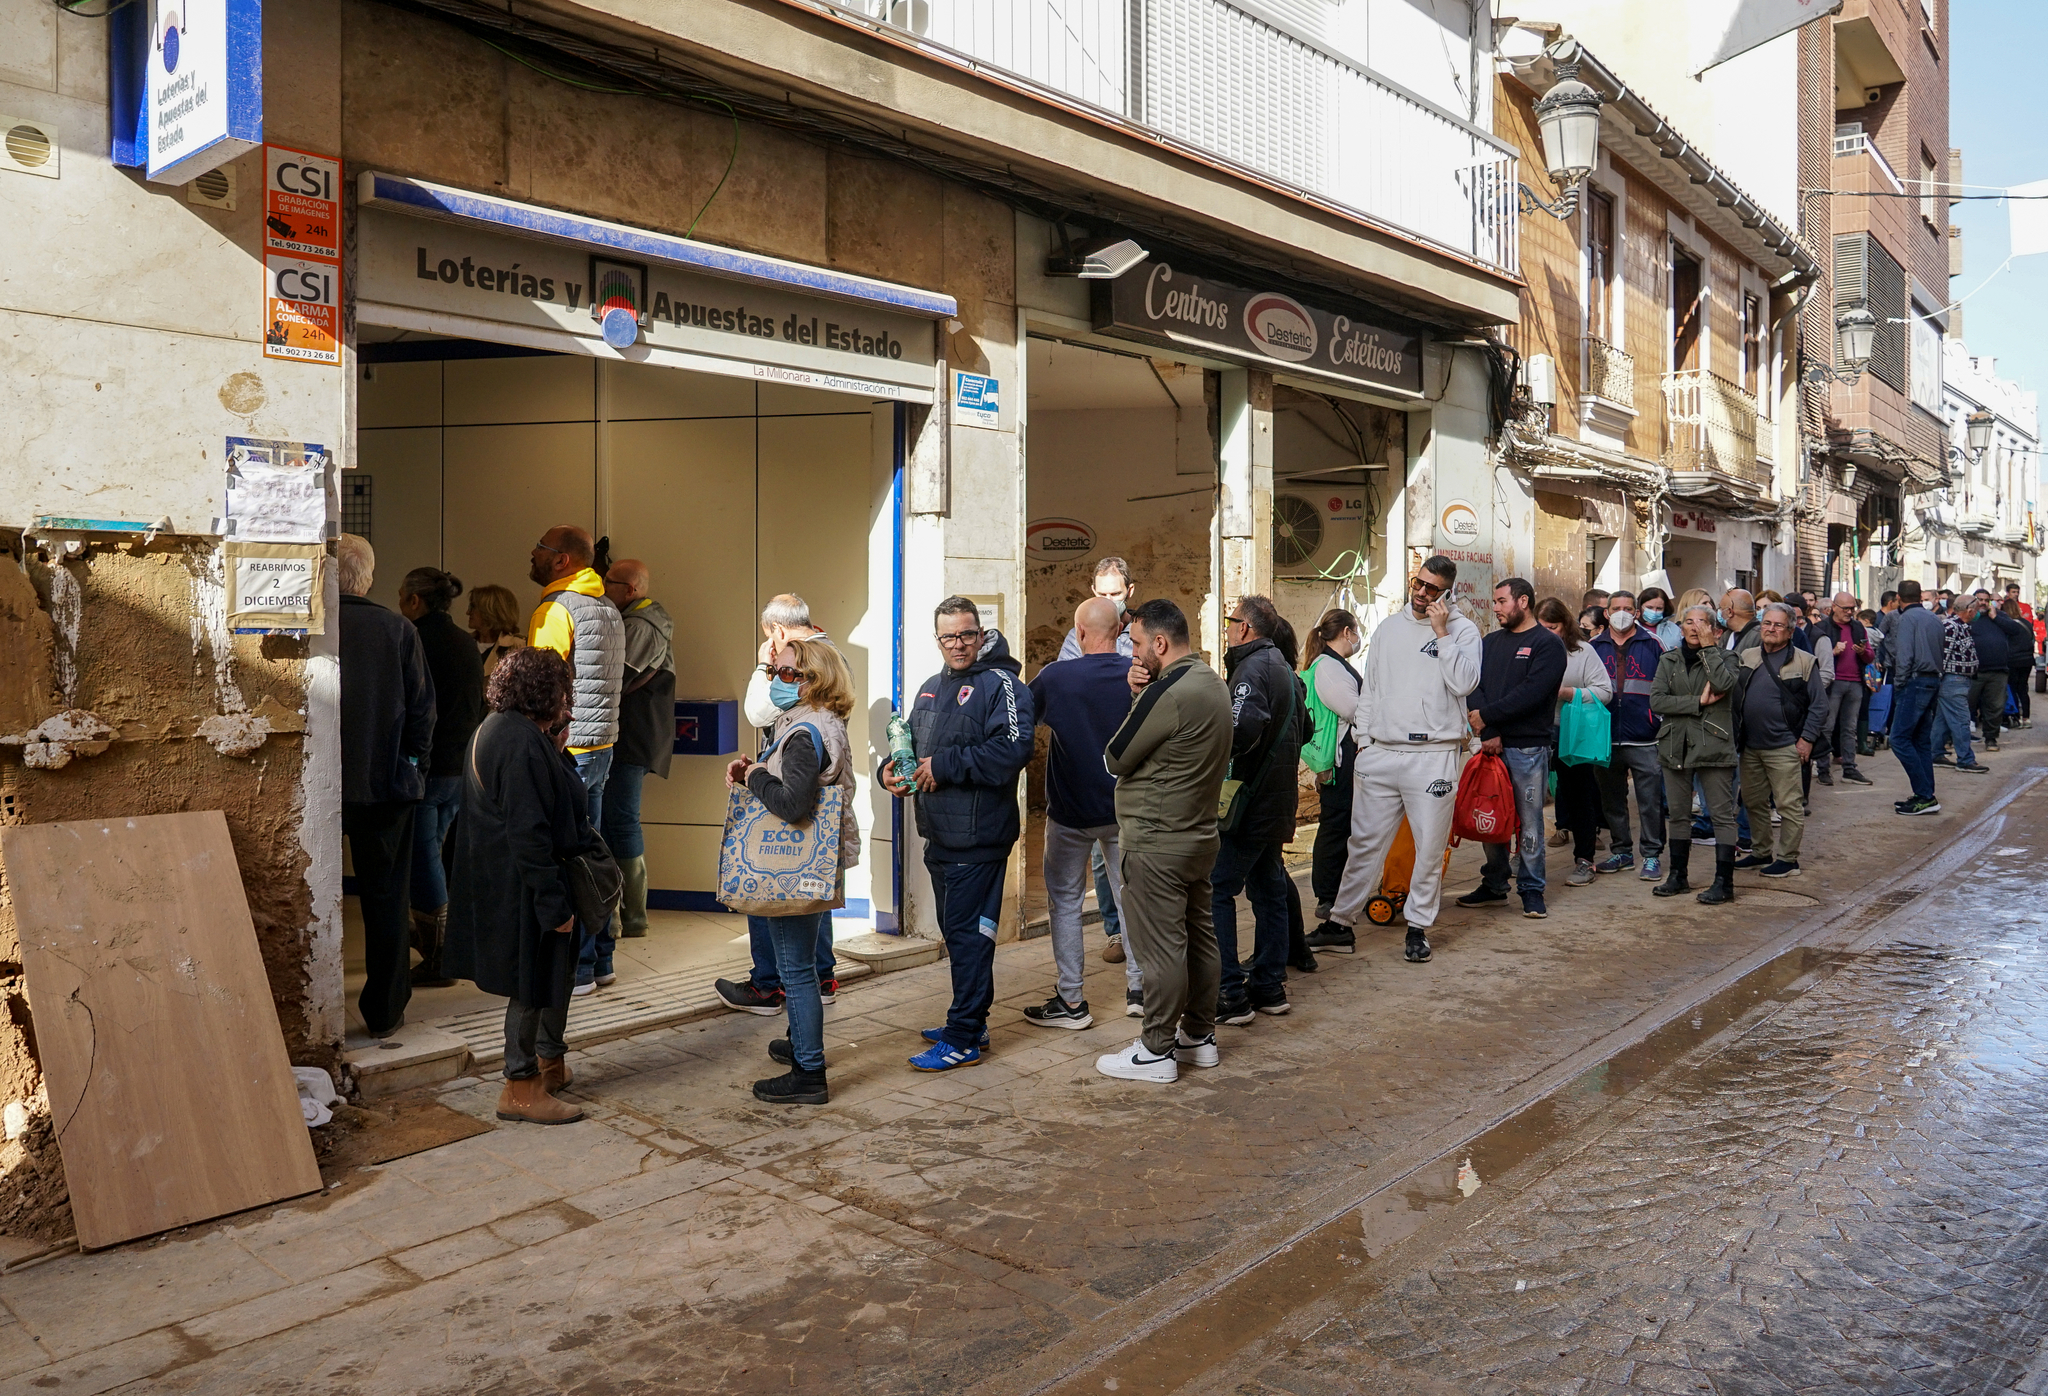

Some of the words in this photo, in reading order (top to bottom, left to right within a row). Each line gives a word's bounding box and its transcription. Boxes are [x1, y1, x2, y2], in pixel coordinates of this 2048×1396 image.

[158, 96, 194, 131] Apuestas
[195, 81, 208, 107] del
[157, 123, 184, 154] Estado
[276, 162, 330, 200] CSI
[277, 194, 329, 211] GRABACIÓN
[278, 203, 290, 212] DE
[290, 206, 330, 220] IMÁGENES
[305, 223, 328, 237] 24h
[270, 238, 285, 248] Tel.
[286, 241, 301, 251] 902
[302, 244, 313, 254] 73
[314, 246, 324, 255] 26
[325, 248, 336, 257] 86
[276, 268, 330, 304] CSI
[416, 246, 556, 301] Loterías
[564, 281, 582, 313] y
[275, 300, 330, 319] ALARMA
[276, 312, 329, 328] CONECTADA
[652, 291, 775, 338] Apuestas
[782, 313, 818, 346] del
[826, 322, 903, 360] Estado
[1145, 262, 1229, 330] Centros
[1328, 314, 1403, 376] Estéticos
[302, 328, 326, 341] 24h
[1267, 322, 1312, 348] Destetic
[270, 345, 284, 354] Tel.
[285, 347, 300, 356] 902
[302, 349, 312, 357] 73
[314, 351, 324, 359] 26
[325, 353, 335, 361] 86
[753, 365, 764, 377] La
[766, 366, 811, 383] Millonaria
[823, 375, 886, 394] Administración
[1345, 500, 1362, 509] LG
[1042, 536, 1091, 547] Destetic
[1466, 551, 1493, 563] FACIALES
[250, 563, 306, 572] REABRIMOS
[273, 578, 280, 589] 2
[244, 595, 309, 606] DICIEMBRE
[761, 830, 805, 843] ECO
[758, 845, 804, 857] FRIENDLY
